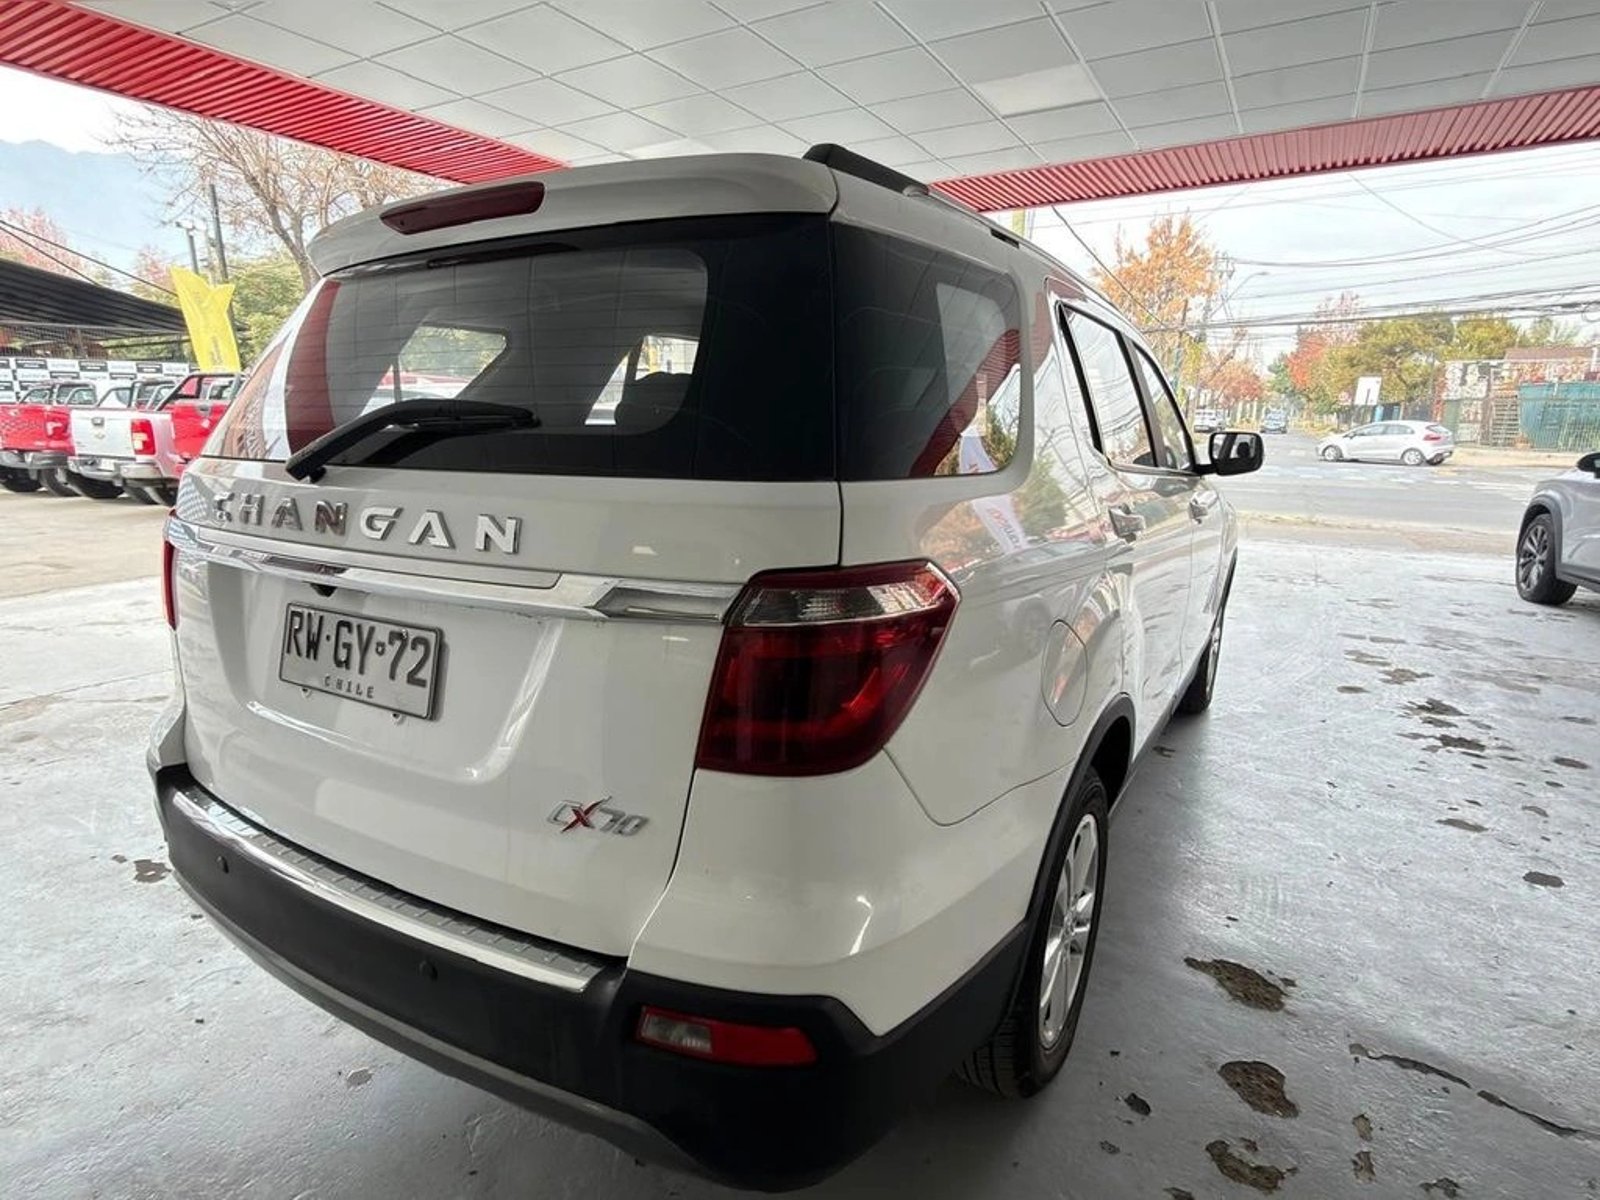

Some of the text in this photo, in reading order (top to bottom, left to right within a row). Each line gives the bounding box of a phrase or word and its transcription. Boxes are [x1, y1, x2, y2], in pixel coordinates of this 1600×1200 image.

[214, 492, 522, 554] CHANGAN
[324, 675, 375, 699] CHILE
[547, 796, 649, 836] CX70
